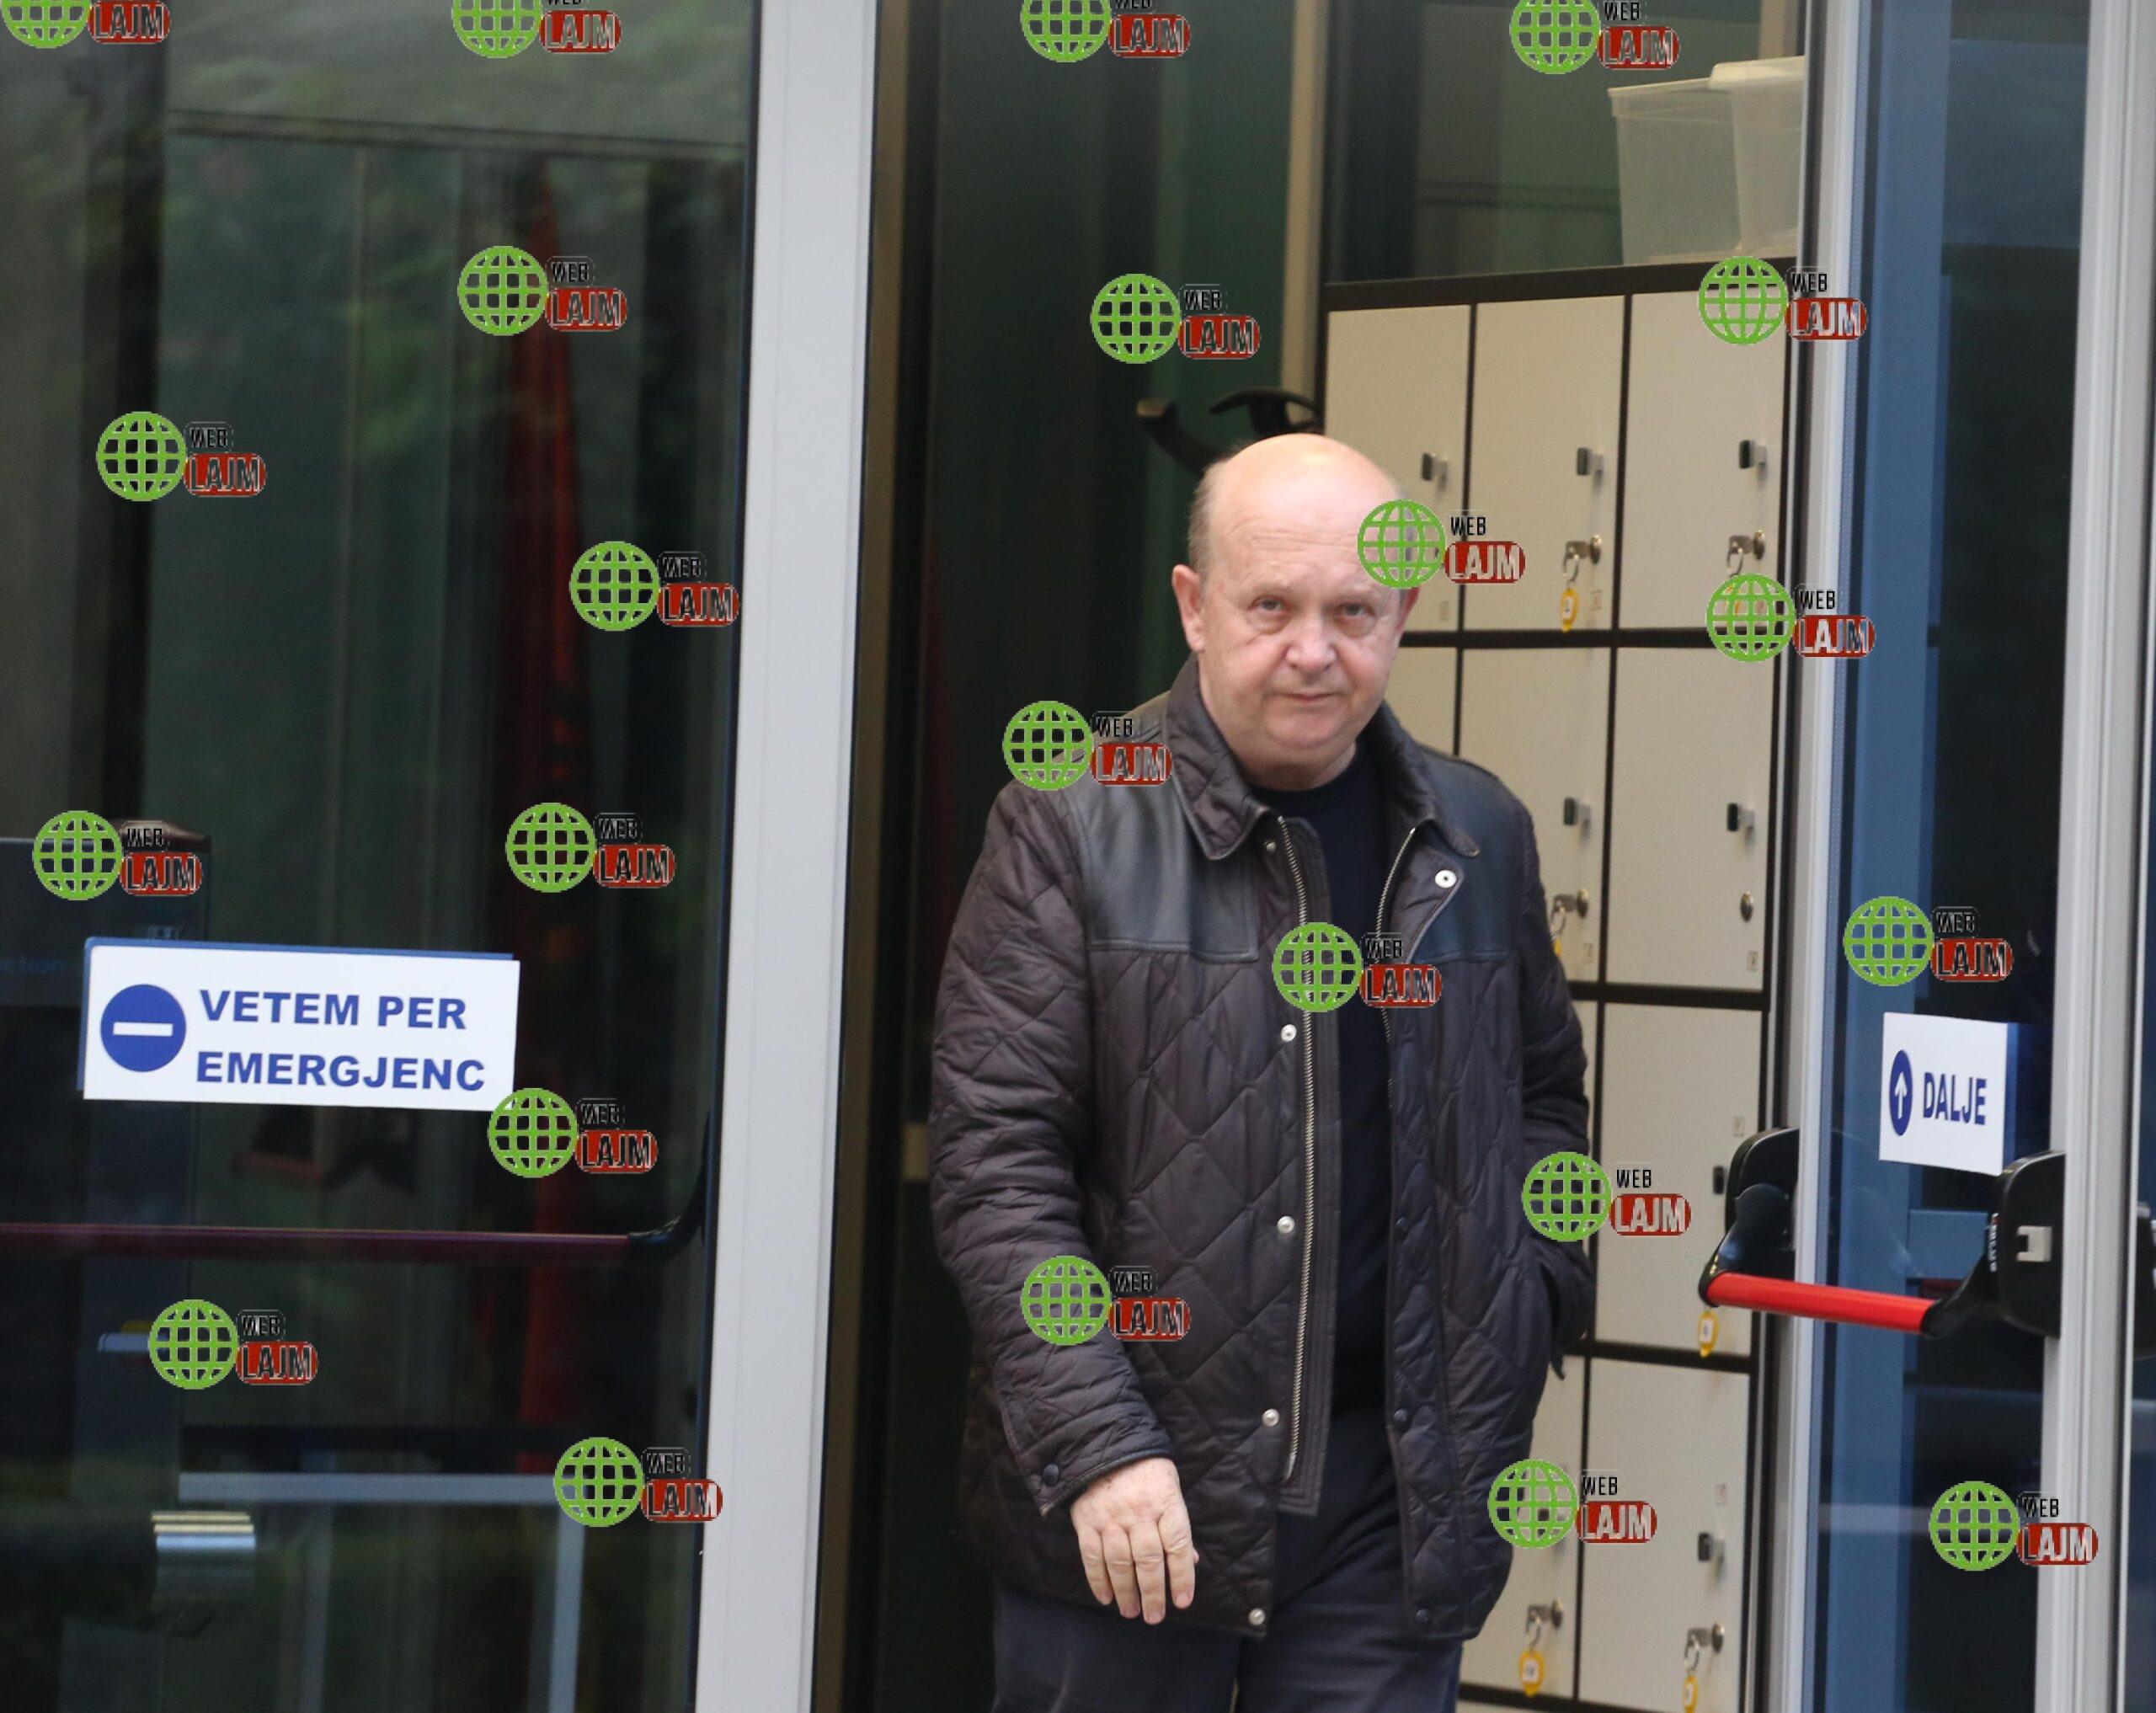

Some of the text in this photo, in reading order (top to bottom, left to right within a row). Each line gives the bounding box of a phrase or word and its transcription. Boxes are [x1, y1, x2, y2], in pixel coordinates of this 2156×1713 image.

[200, 989, 467, 1030] VETEM PER
[196, 1050, 486, 1091] EMERGJENC
[1923, 1071, 1988, 1126] DALJE
